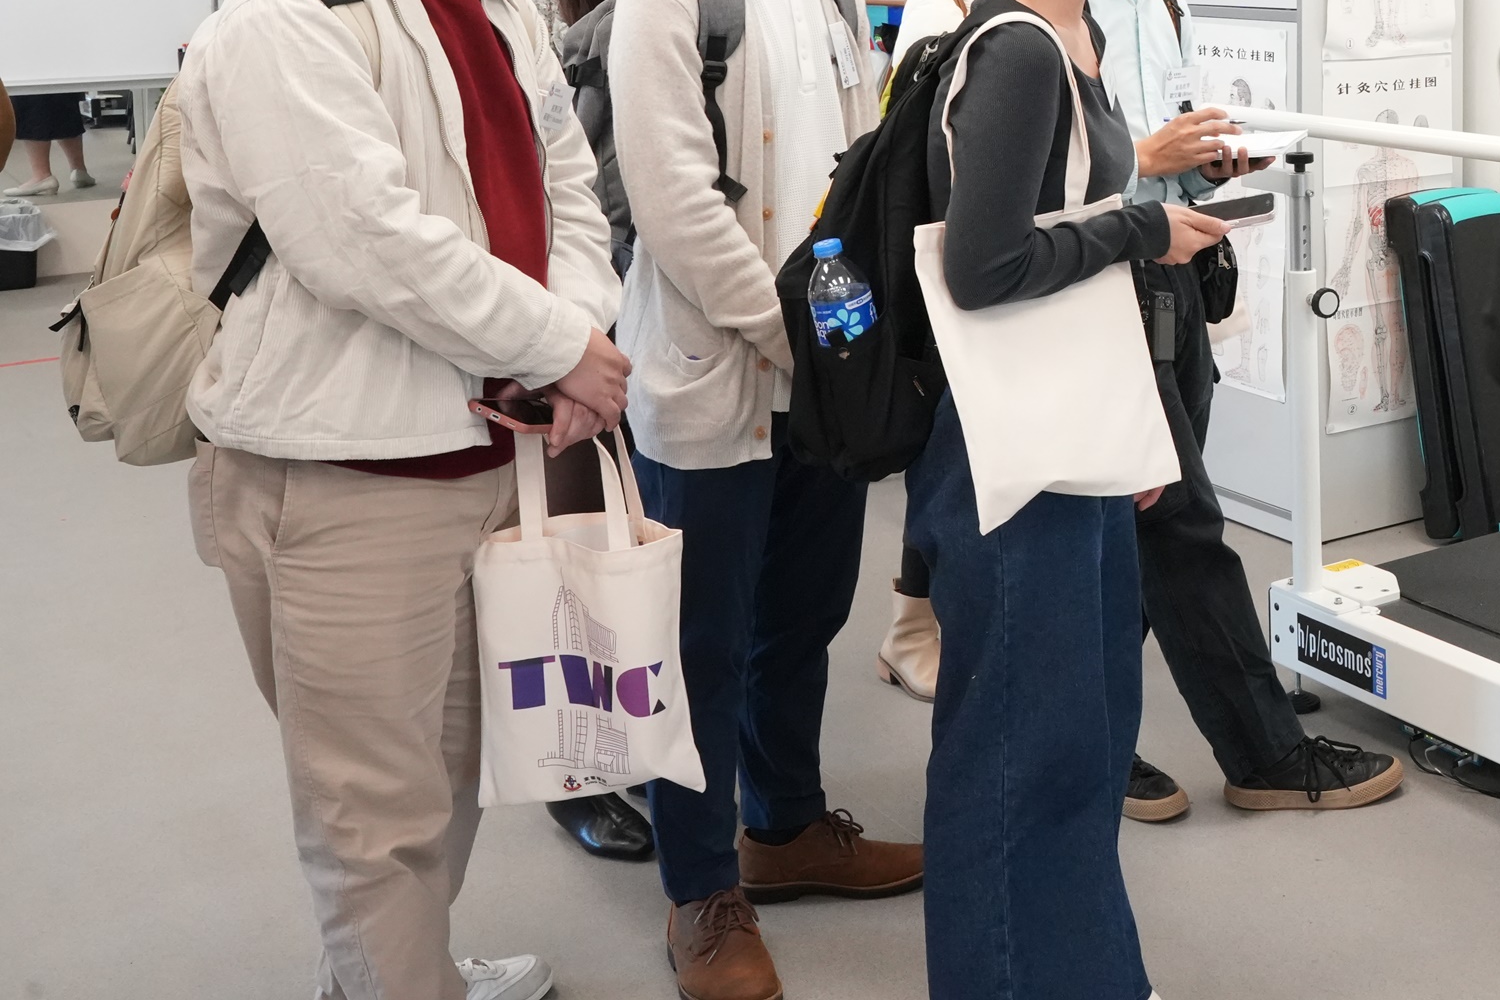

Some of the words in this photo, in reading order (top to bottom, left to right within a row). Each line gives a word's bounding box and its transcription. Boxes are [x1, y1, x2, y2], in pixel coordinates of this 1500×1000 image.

[1197, 44, 1275, 63] 针灸穴位挂图
[1336, 76, 1437, 95] 针灸穴位挂图
[498, 654, 666, 718] TWC
[1375, 650, 1385, 695] mercury
